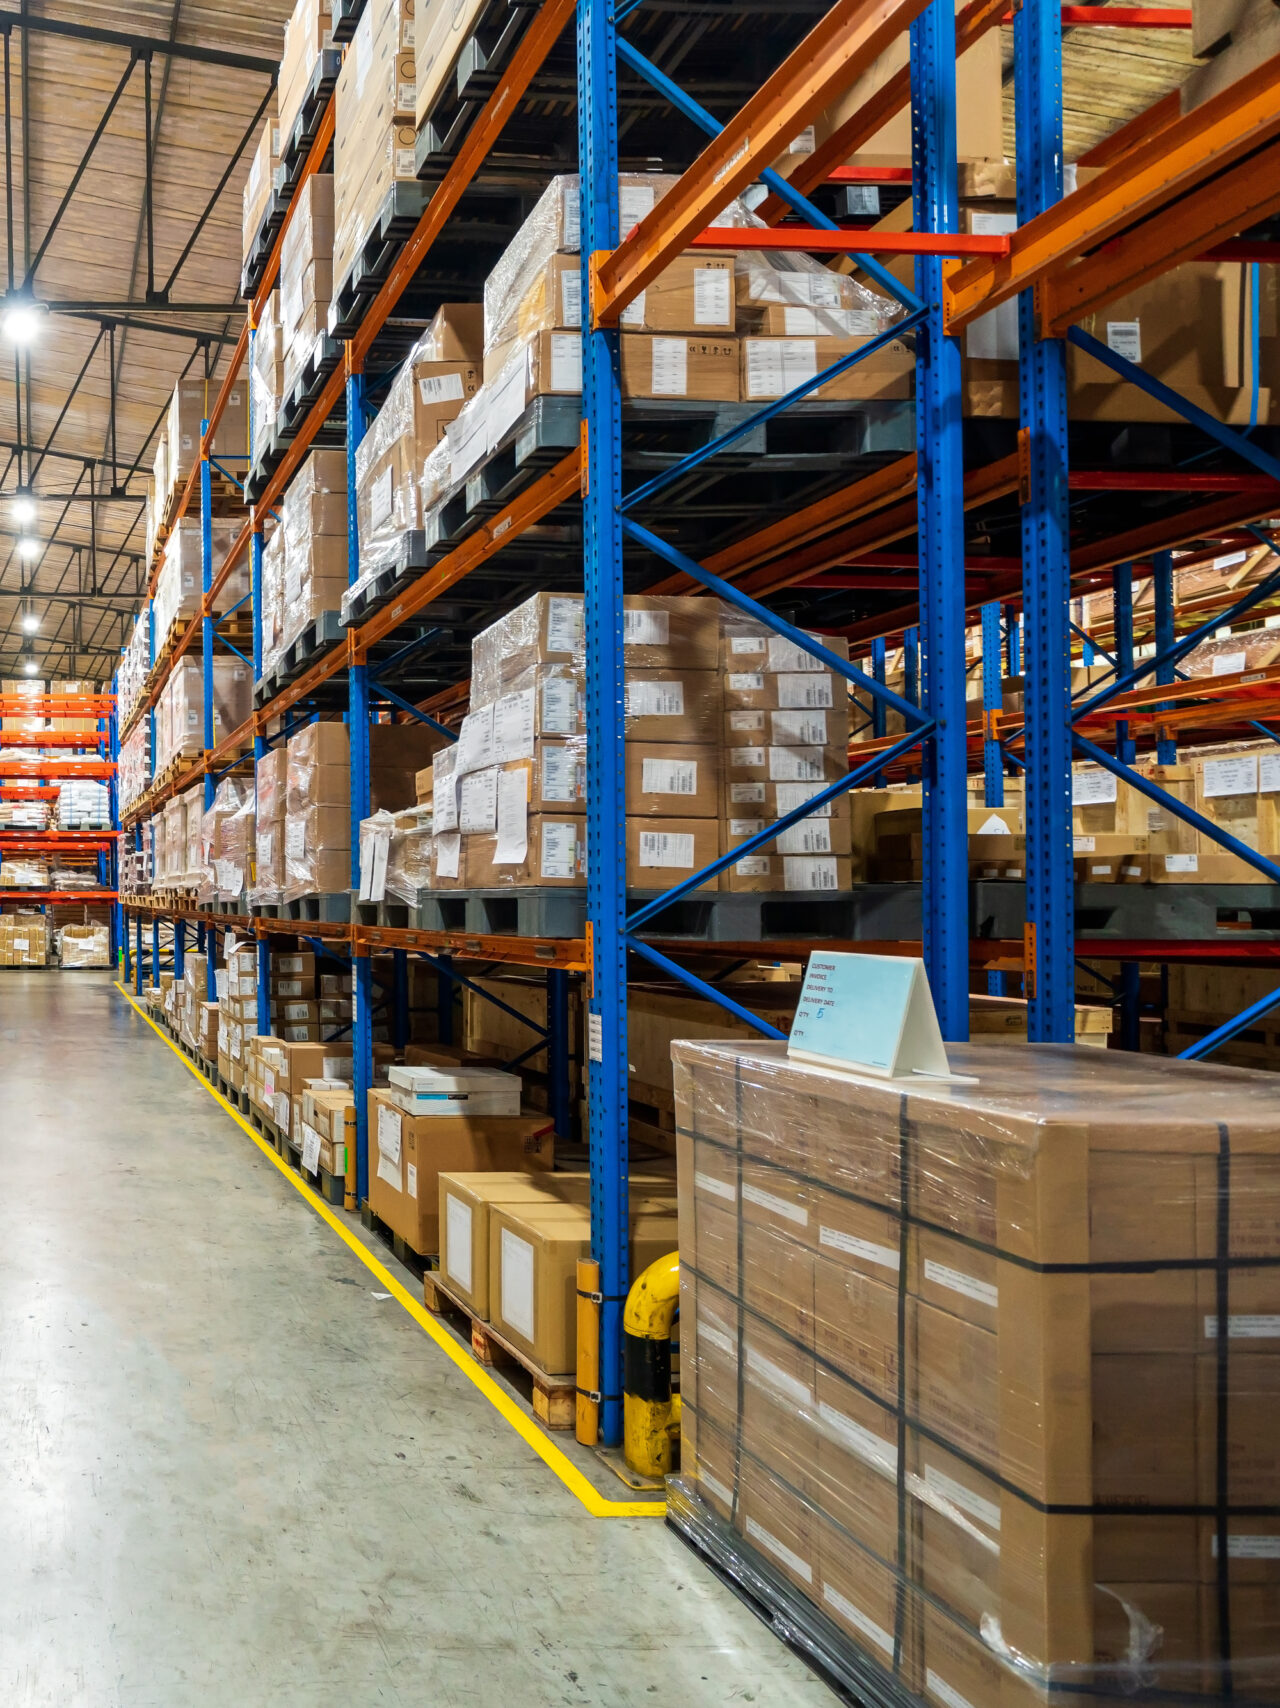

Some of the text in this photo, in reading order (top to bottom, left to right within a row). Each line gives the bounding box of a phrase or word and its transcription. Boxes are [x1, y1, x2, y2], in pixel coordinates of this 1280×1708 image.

[811, 963, 836, 971] CUSTOMER
[809, 973, 827, 981] INVOICE
[806, 984, 826, 992] DELIVERY
[803, 996, 823, 1004] DELIVERY
